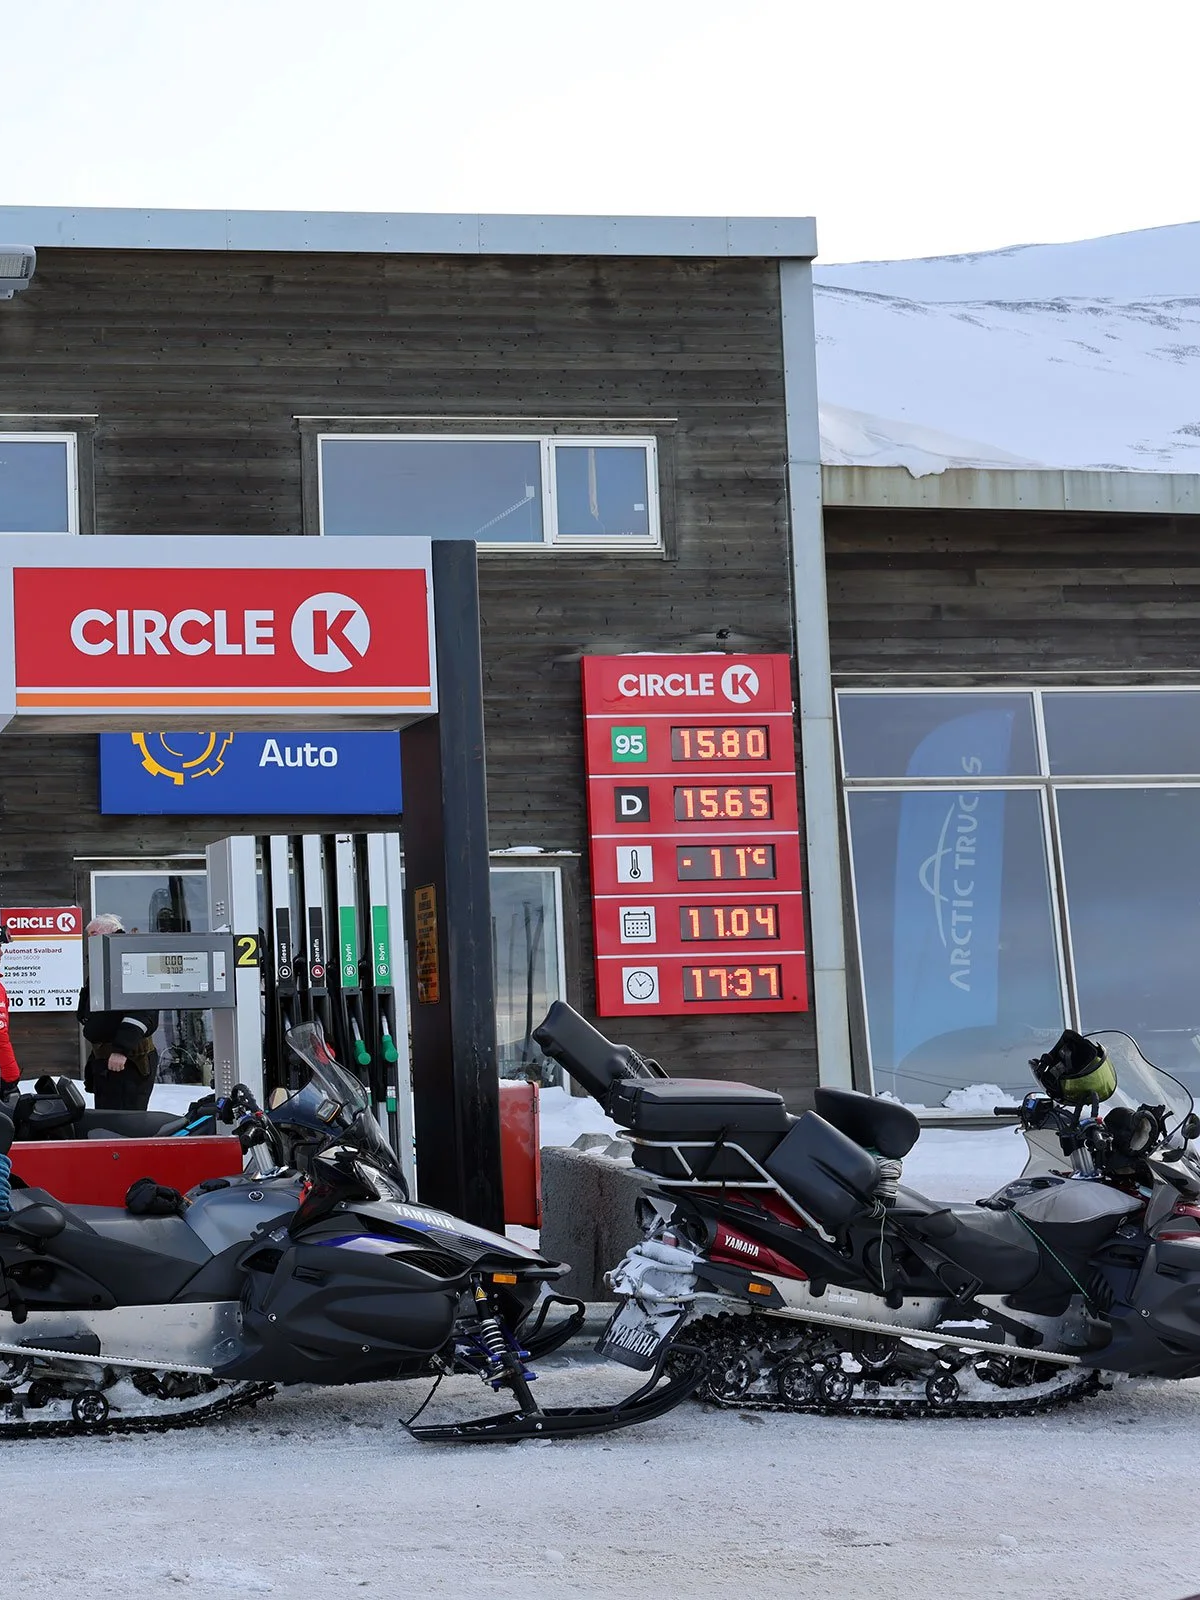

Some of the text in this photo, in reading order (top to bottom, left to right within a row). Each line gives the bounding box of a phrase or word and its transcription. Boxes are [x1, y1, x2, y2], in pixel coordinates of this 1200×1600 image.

[70, 607, 369, 670] CIRCLE K
[617, 673, 715, 697] CIRCLE
[258, 738, 338, 768] Auto
[615, 729, 765, 758] 95 15.80
[620, 788, 768, 818] D 15.65
[949, 756, 983, 992] ARCTIC TRUCS
[6, 916, 54, 929] CIRCLE
[689, 908, 774, 938] 11.04
[237, 937, 258, 965] 2
[313, 938, 321, 963] parafin
[345, 944, 353, 962] blyfri
[378, 943, 386, 961] blyfri
[691, 967, 778, 998] 17:37
[28, 997, 46, 1007] 112
[55, 996, 73, 1006] 113
[392, 1204, 456, 1231] YAMAHA
[724, 1234, 760, 1257] YAMAHA
[610, 1325, 661, 1357] YAMAHA
